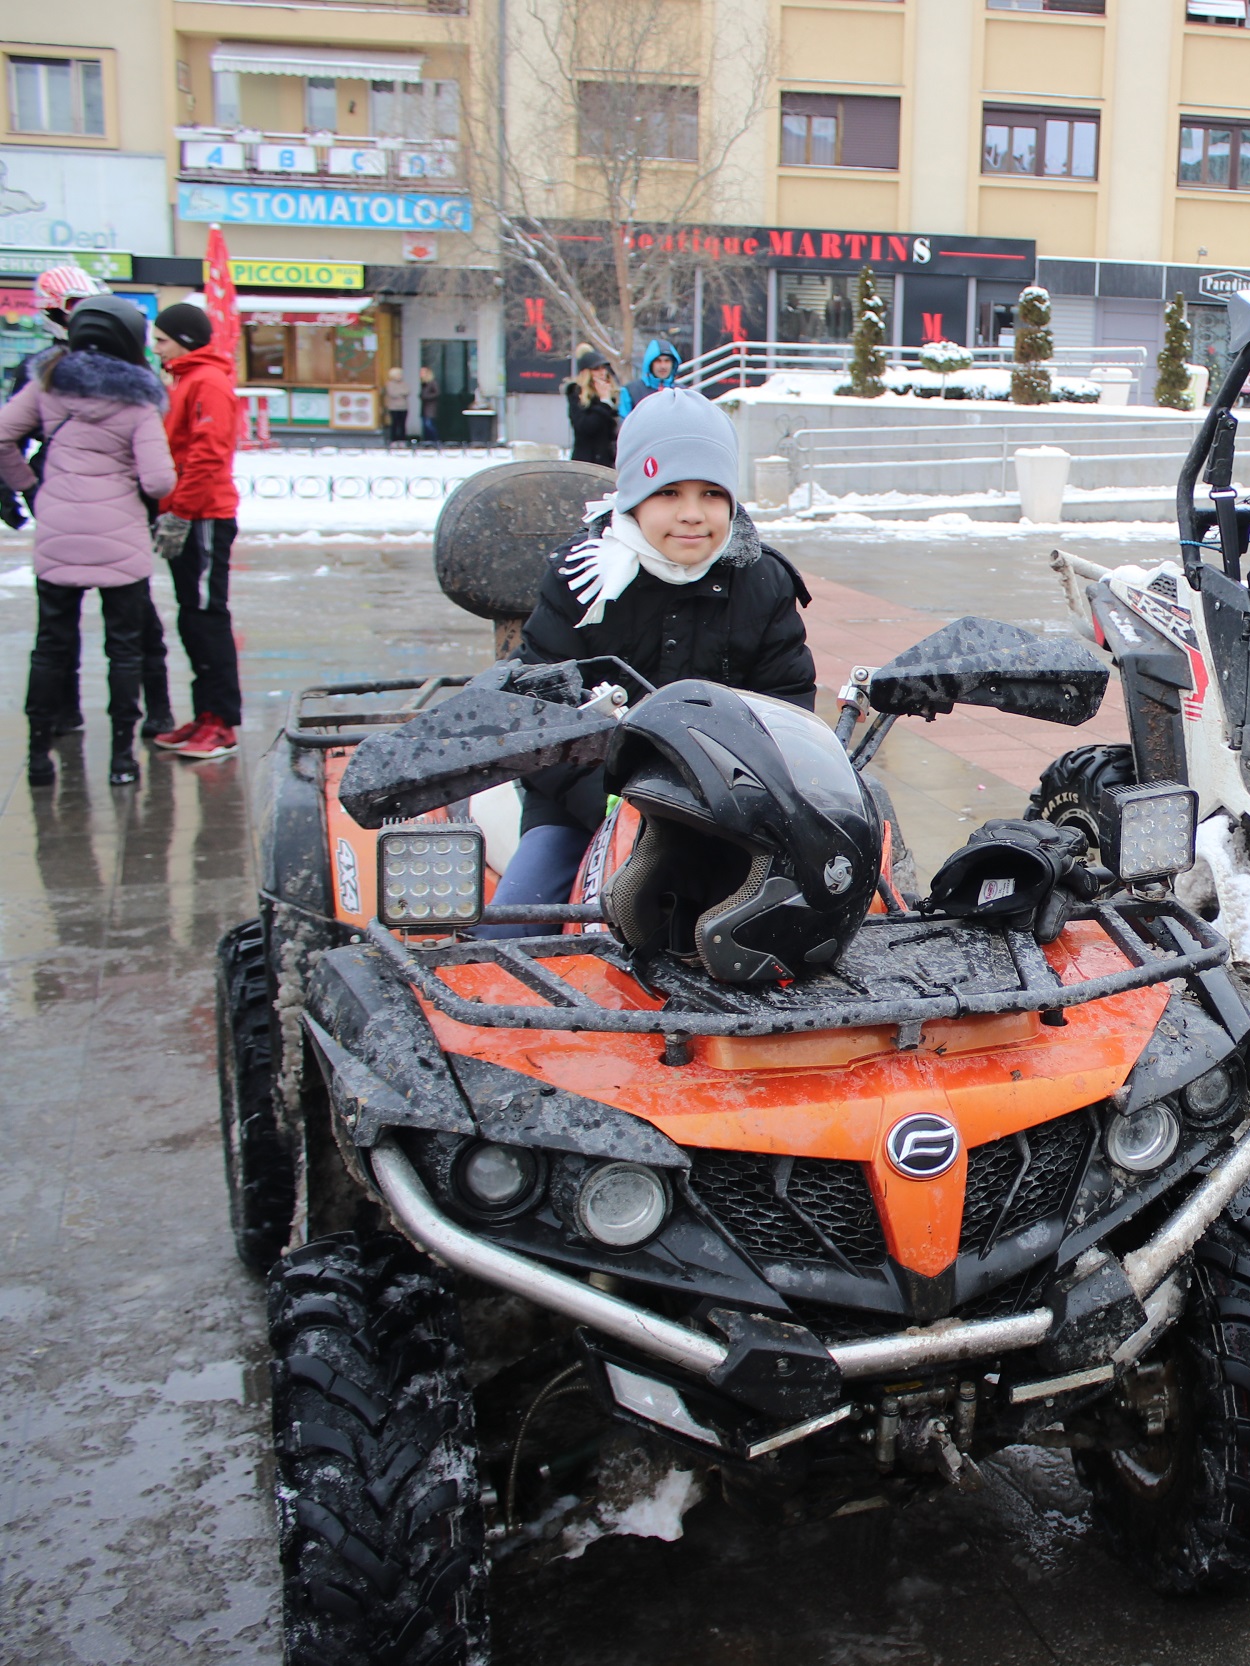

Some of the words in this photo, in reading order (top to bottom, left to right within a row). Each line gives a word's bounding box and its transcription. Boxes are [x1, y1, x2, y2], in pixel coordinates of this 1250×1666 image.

[206, 147, 223, 165] A
[279, 150, 295, 168] B
[352, 152, 366, 171] C
[230, 191, 465, 226] STOMATOLOG
[767, 230, 932, 264] MARTINS
[233, 264, 334, 284] PICCOLO
[1137, 594, 1191, 641] RZR
[1041, 791, 1079, 821] MAXXIS
